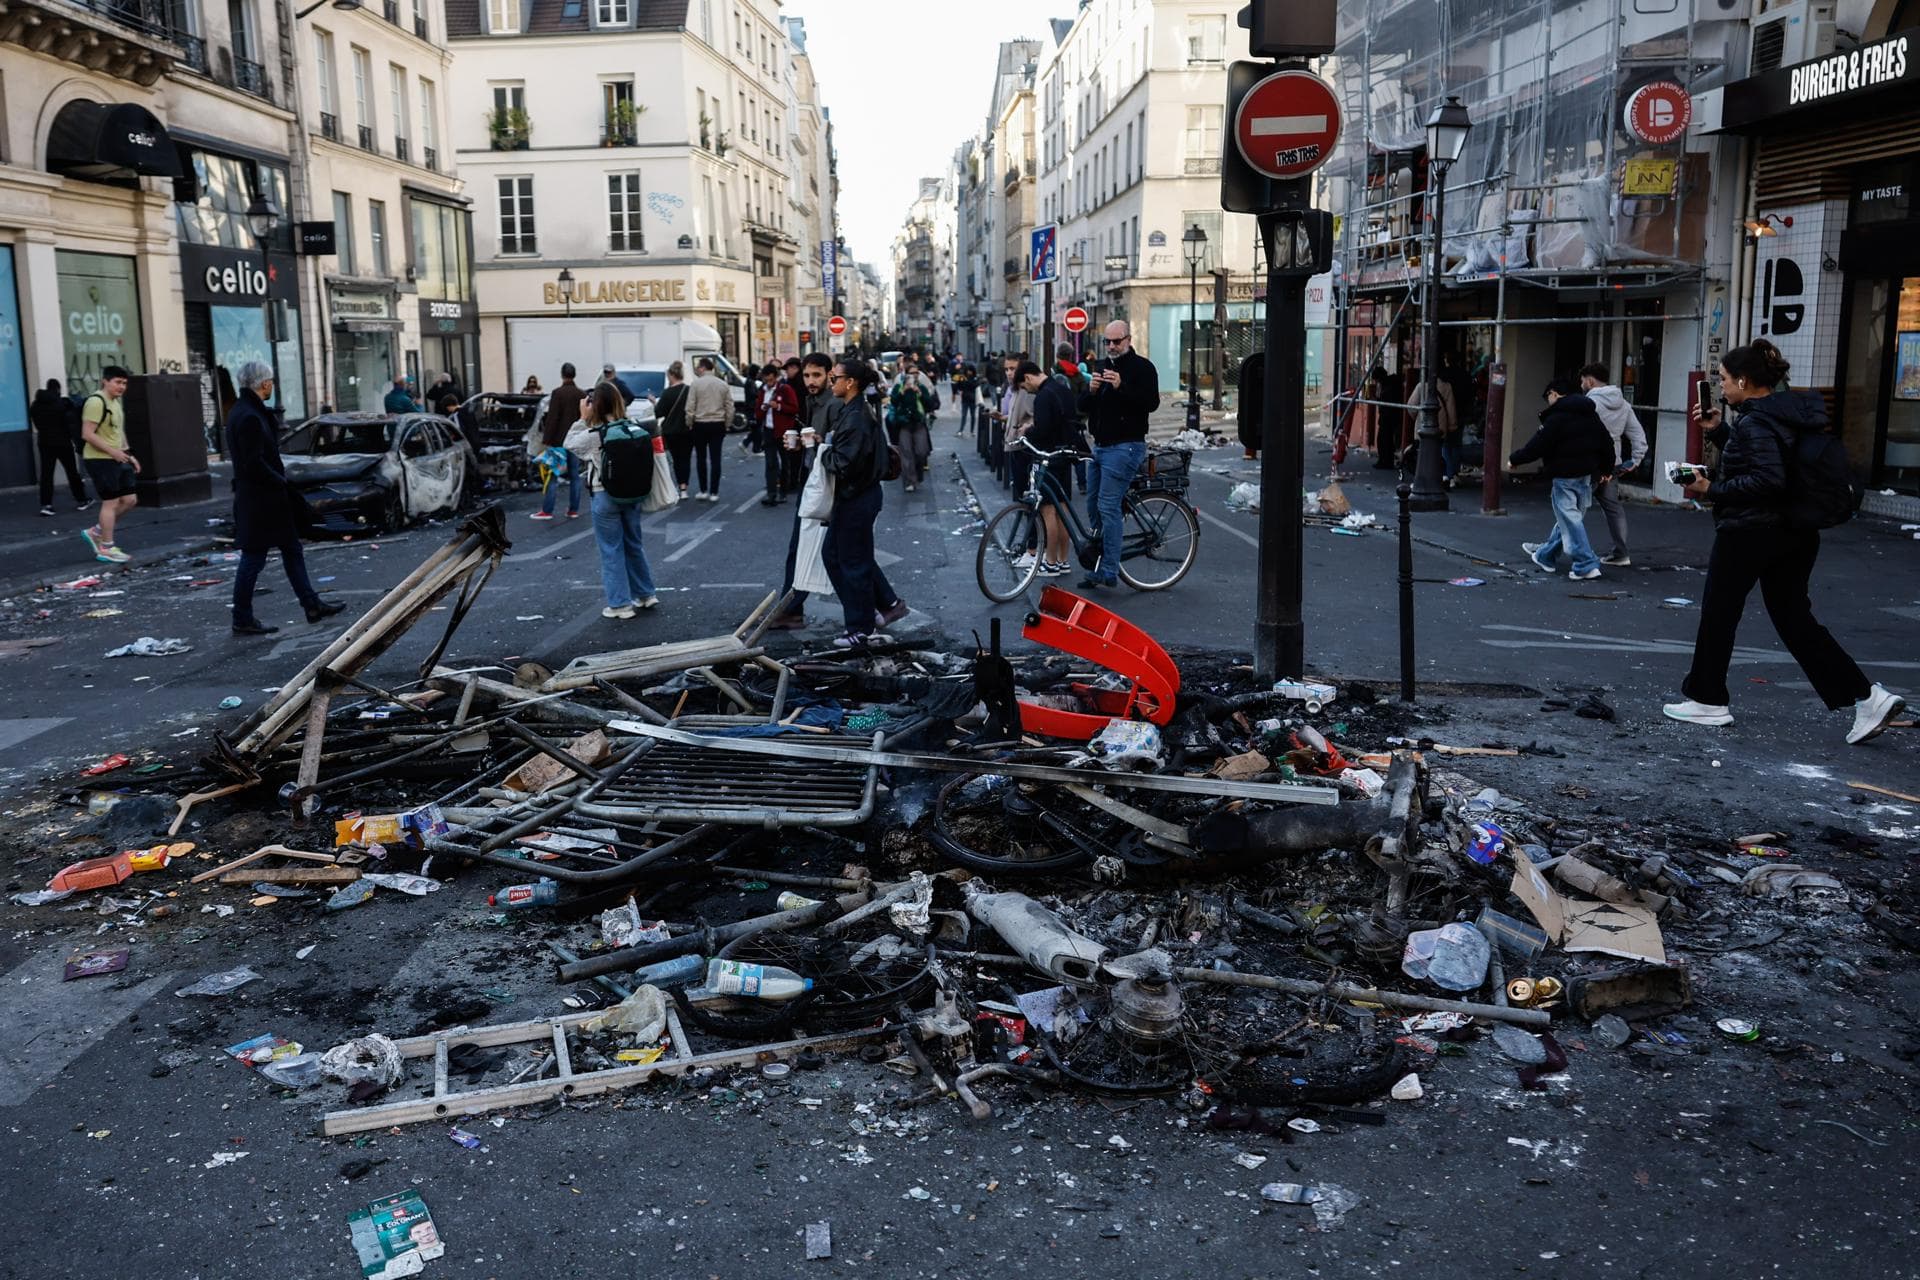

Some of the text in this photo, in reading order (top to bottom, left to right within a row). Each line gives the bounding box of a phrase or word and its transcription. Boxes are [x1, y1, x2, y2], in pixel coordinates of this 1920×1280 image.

[1790, 55, 1848, 105] BURGER
[1848, 50, 1860, 90] &
[1862, 185, 1902, 201] MY TASTE
[304, 234, 328, 242] celio
[206, 261, 267, 295] celio
[543, 279, 686, 305] BOULANGERIE
[696, 278, 710, 301] &
[1309, 287, 1324, 303] PIZZA
[68, 305, 124, 335] celio
